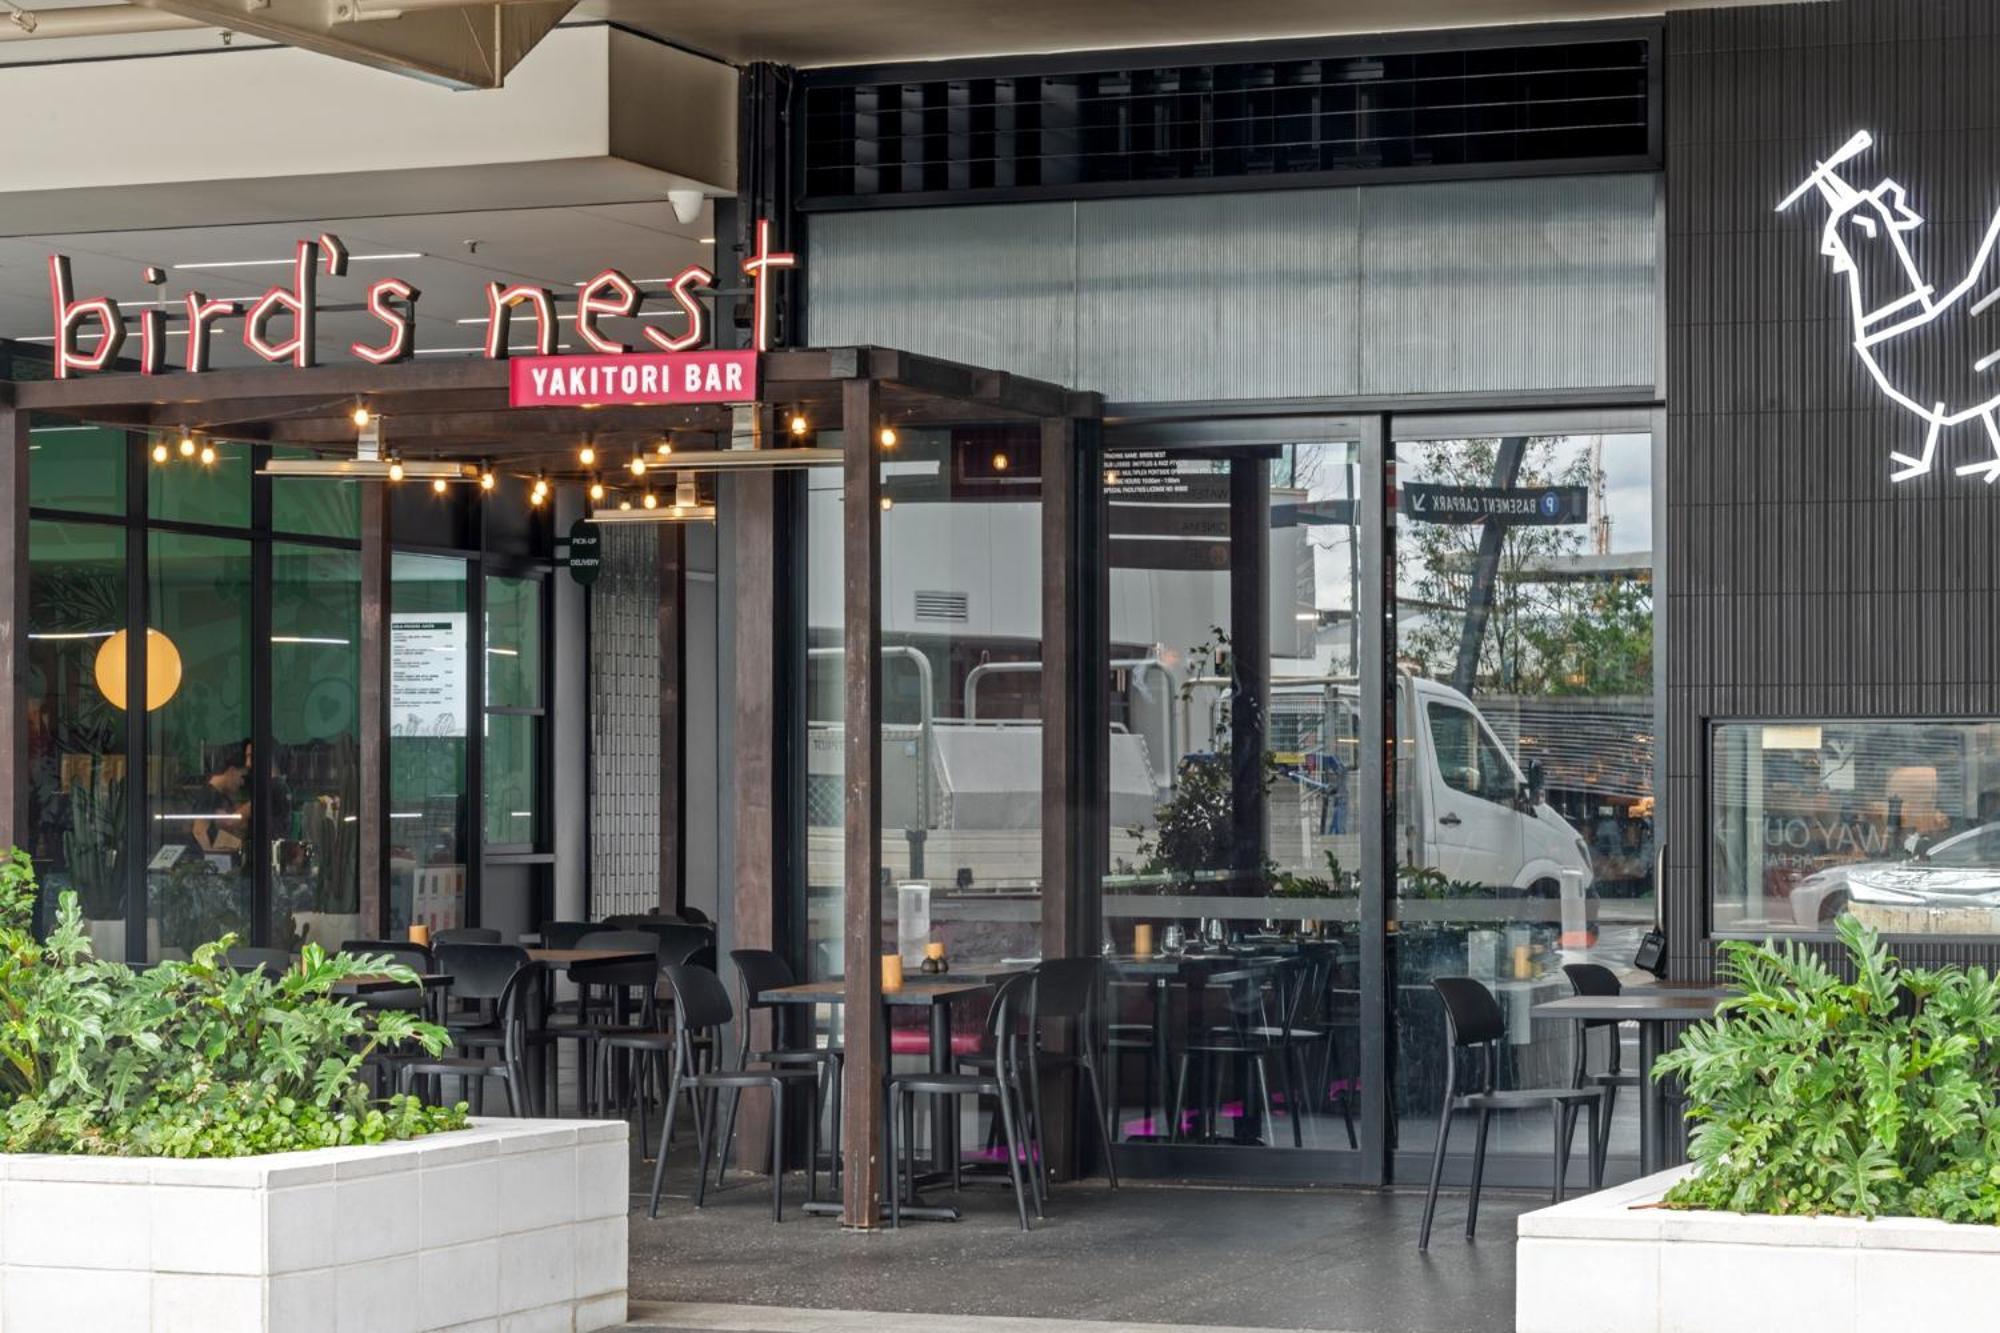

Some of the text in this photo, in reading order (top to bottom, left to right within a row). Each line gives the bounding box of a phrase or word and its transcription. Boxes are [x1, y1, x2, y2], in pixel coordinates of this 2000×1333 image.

[49, 218, 796, 379] bird's nest
[530, 362, 743, 397] YAKITORI BAR
[570, 558, 599, 567] DELIVERY
